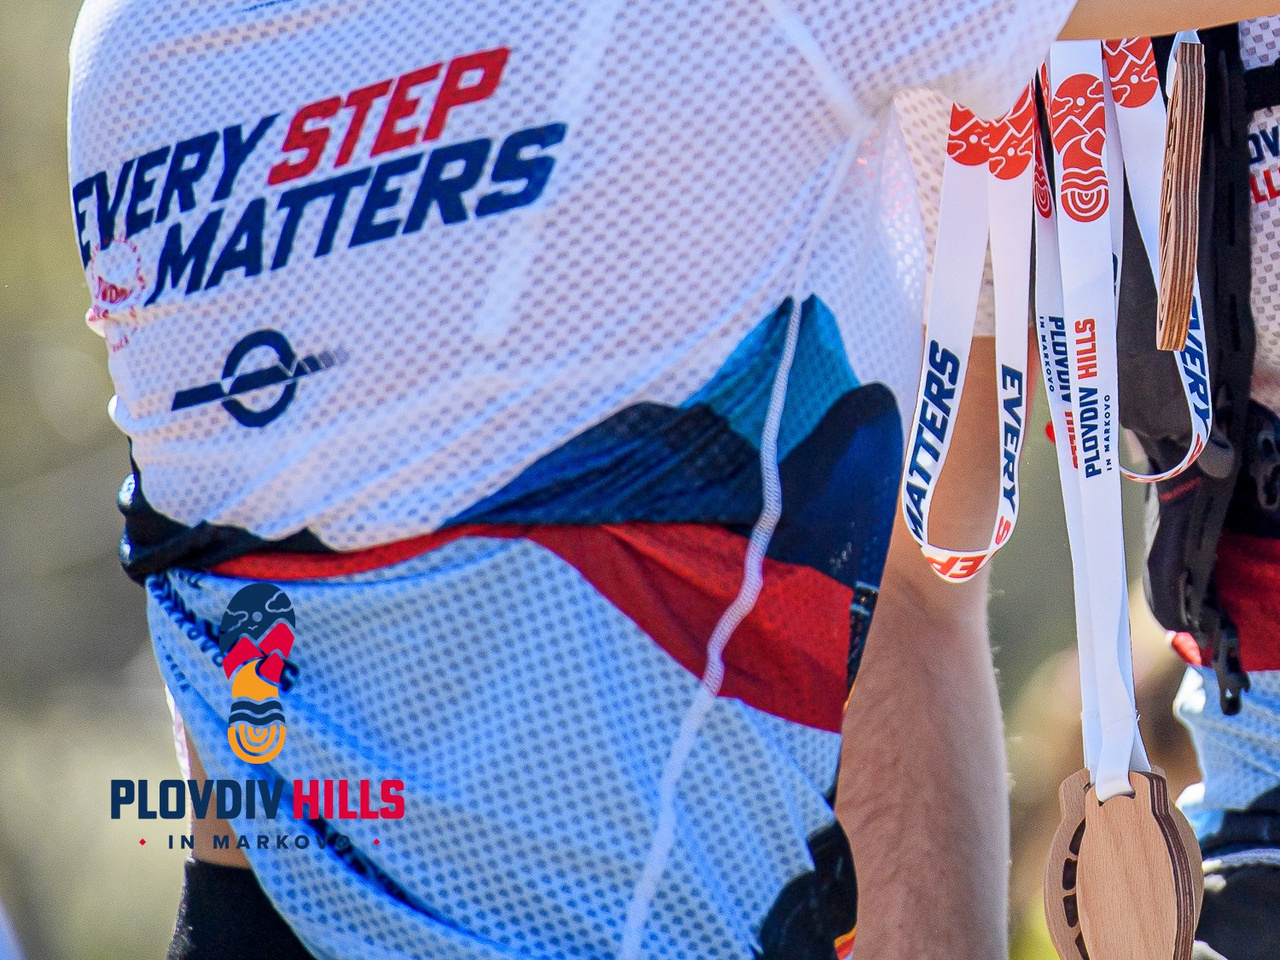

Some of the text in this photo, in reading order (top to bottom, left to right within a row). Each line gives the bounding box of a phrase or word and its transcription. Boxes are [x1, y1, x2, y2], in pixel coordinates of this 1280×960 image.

[72, 45, 512, 271] EVERY STEP
[144, 121, 570, 307] MATTERS
[1039, 315, 1055, 393] IN MARKOVO
[1074, 317, 1102, 479] PLOVDIV HILLS
[1103, 394, 1113, 471] IN MARKOVO
[905, 339, 961, 542] MATTERS
[1001, 363, 1024, 515] EVERY
